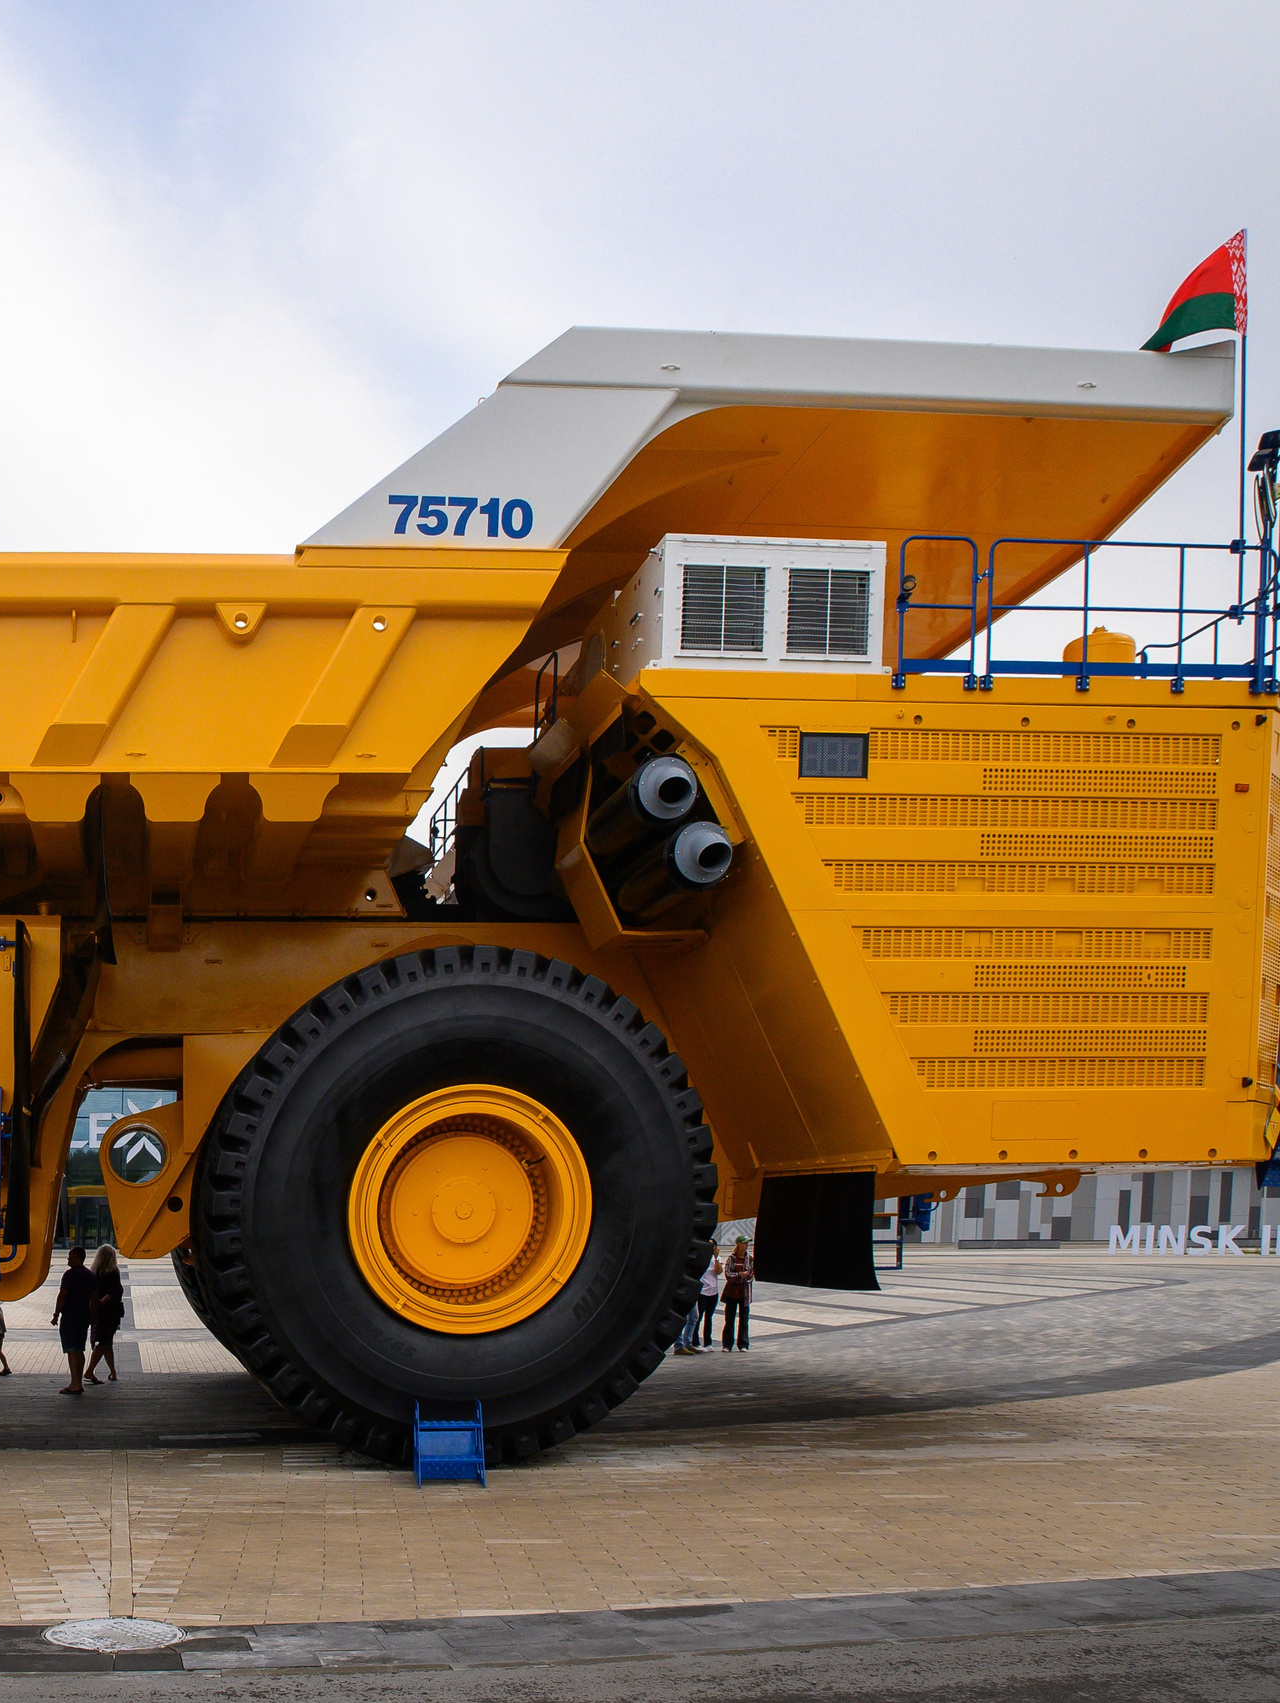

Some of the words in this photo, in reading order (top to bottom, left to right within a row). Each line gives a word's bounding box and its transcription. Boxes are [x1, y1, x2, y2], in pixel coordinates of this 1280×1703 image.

[388, 494, 534, 540] 75710
[1108, 1224, 1246, 1257] MINSK
[1261, 1224, 1280, 1257] I
